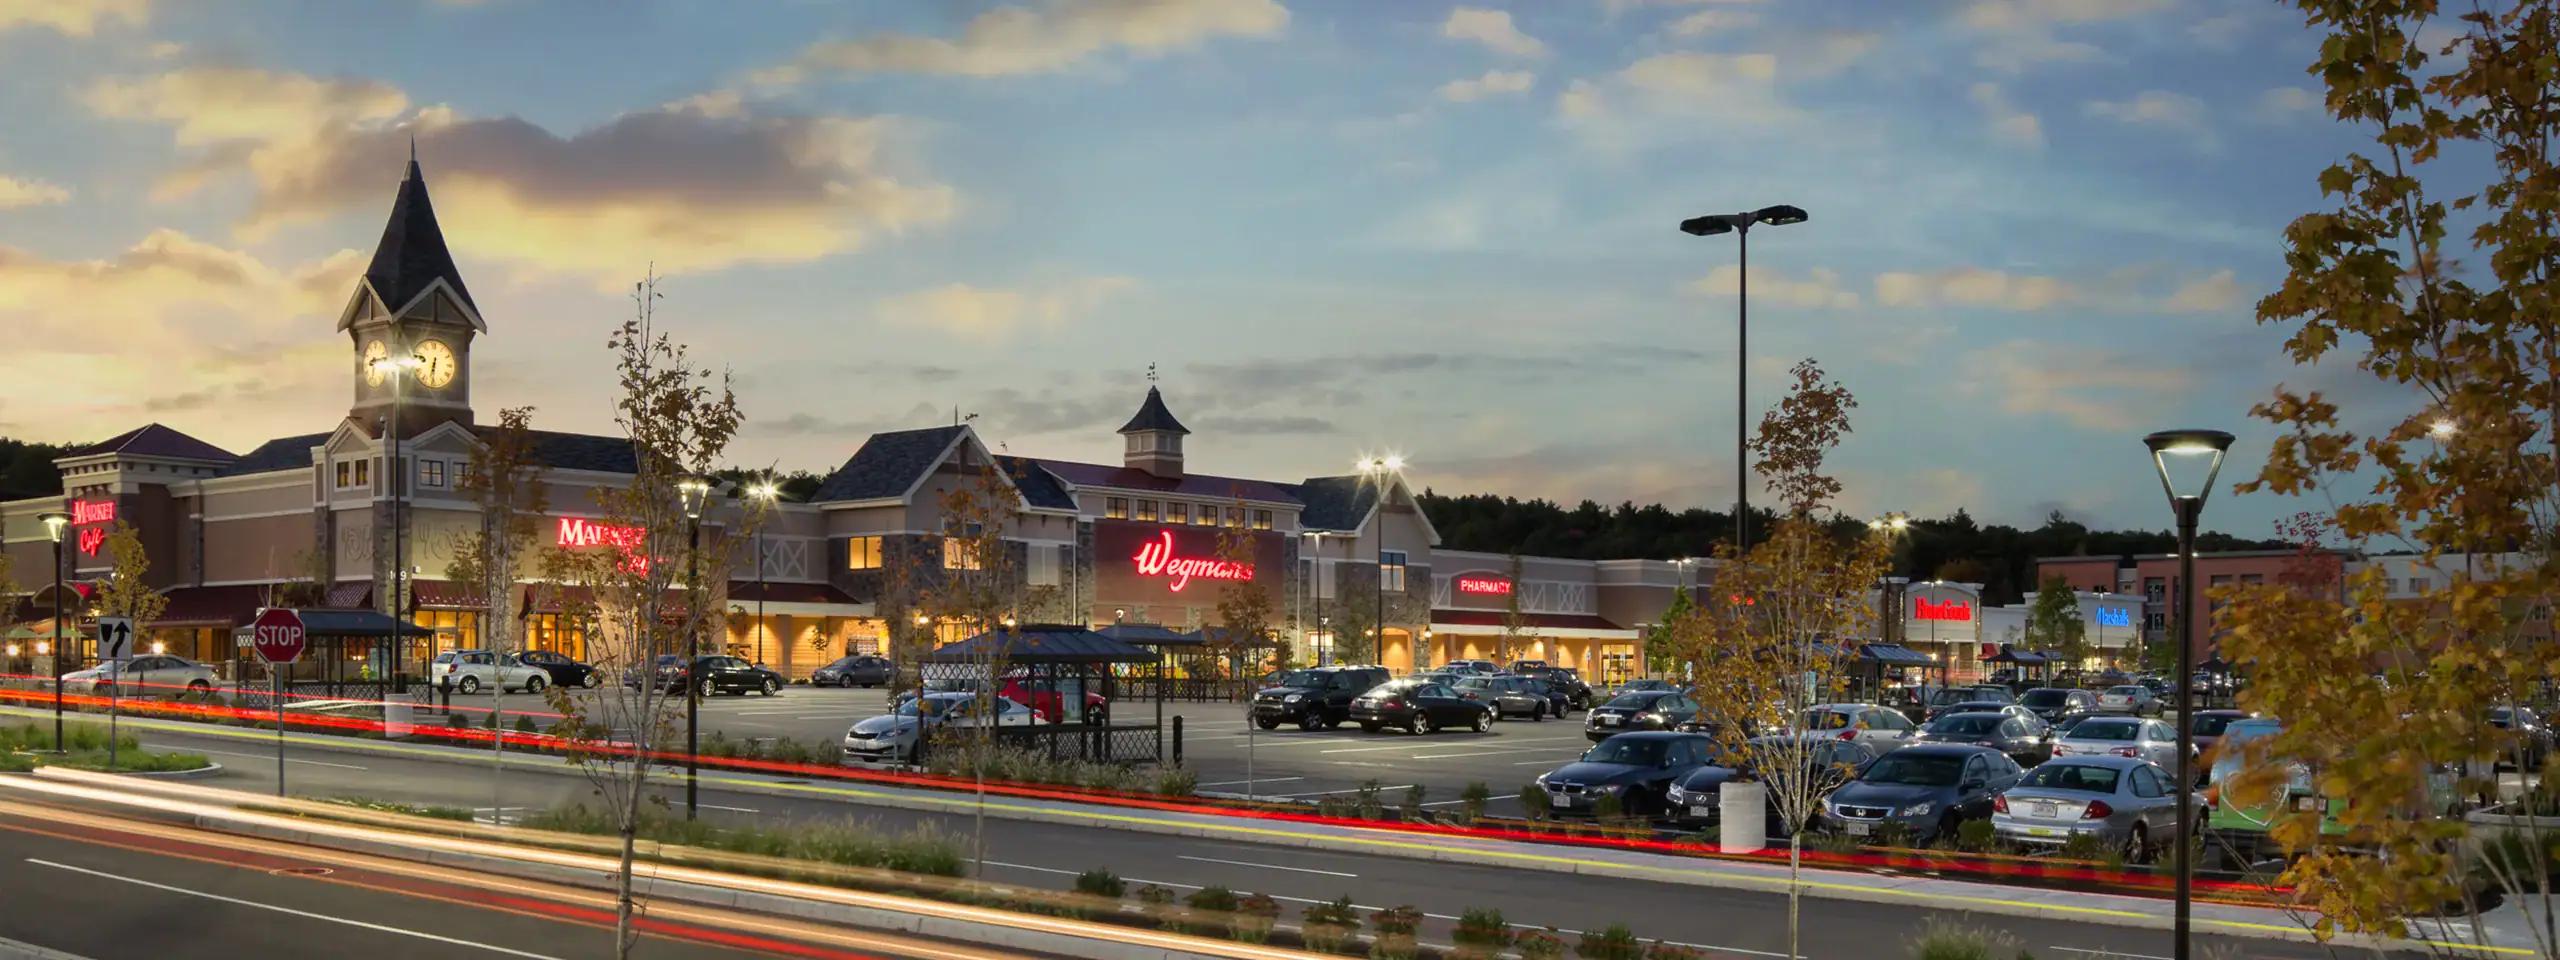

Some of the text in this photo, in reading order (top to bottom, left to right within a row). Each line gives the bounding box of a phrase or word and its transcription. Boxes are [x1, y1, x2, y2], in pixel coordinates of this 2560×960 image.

[390, 570, 406, 581] 19
[1461, 579, 1511, 593] PHARMACY
[258, 625, 301, 646] STOP
